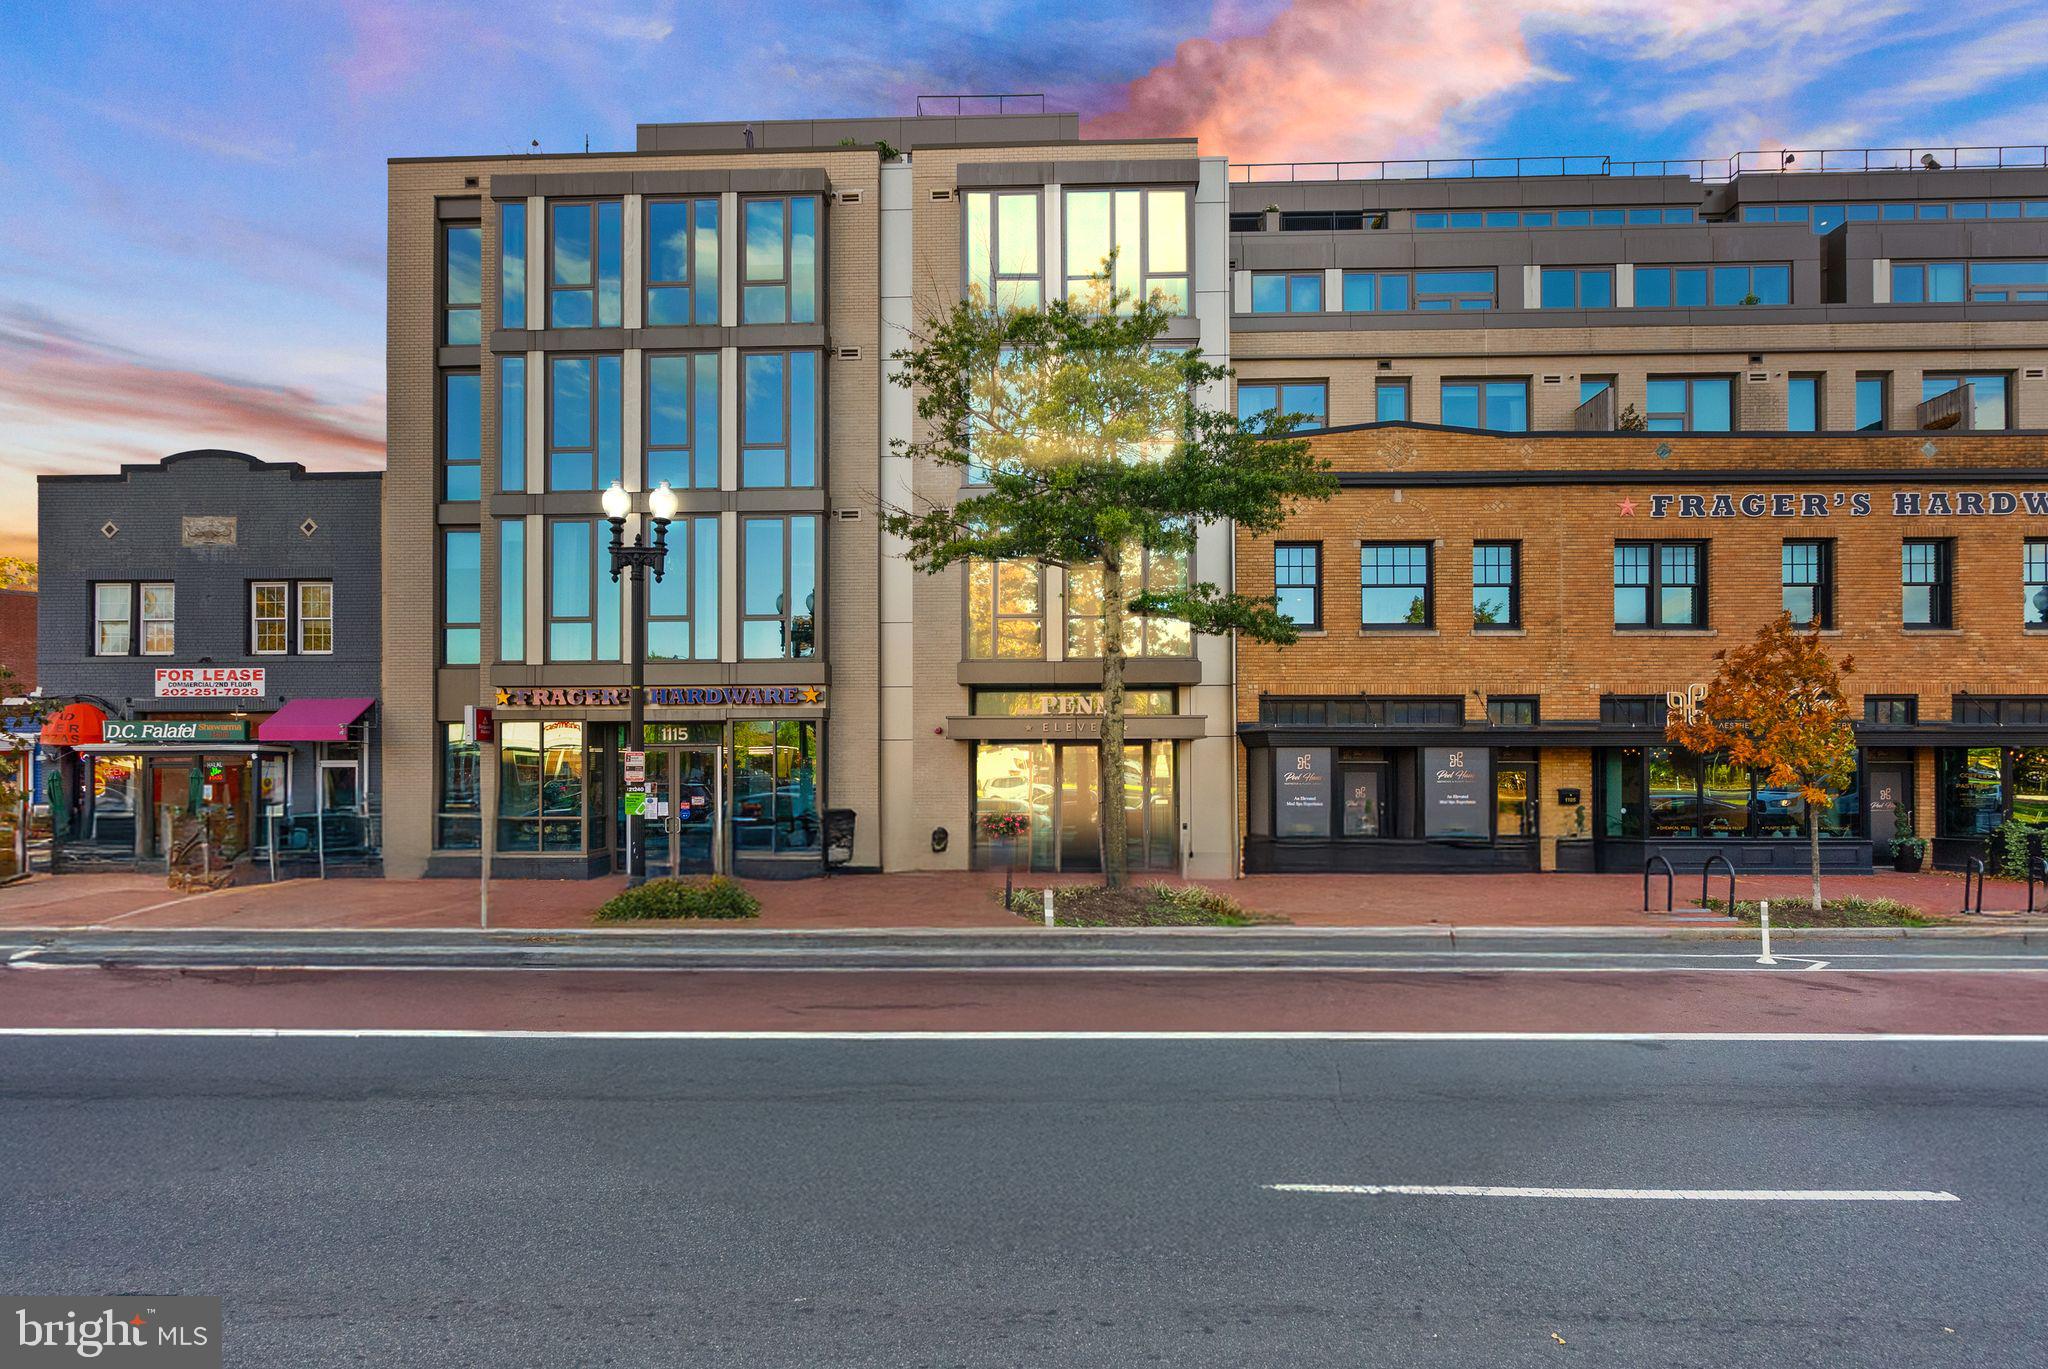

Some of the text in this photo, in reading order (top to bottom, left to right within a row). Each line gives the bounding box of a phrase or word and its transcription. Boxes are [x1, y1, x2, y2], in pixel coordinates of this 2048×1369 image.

[1650, 492, 1872, 518] FRAGER'S
[157, 669, 264, 681] FOR LEASE
[161, 688, 259, 696] 202-251-7928
[515, 687, 799, 706] FRAGER' HARDWARE
[106, 723, 198, 739] D.C. Falafel
[661, 727, 689, 741] 1115
[1042, 722, 1098, 732] ELEVE
